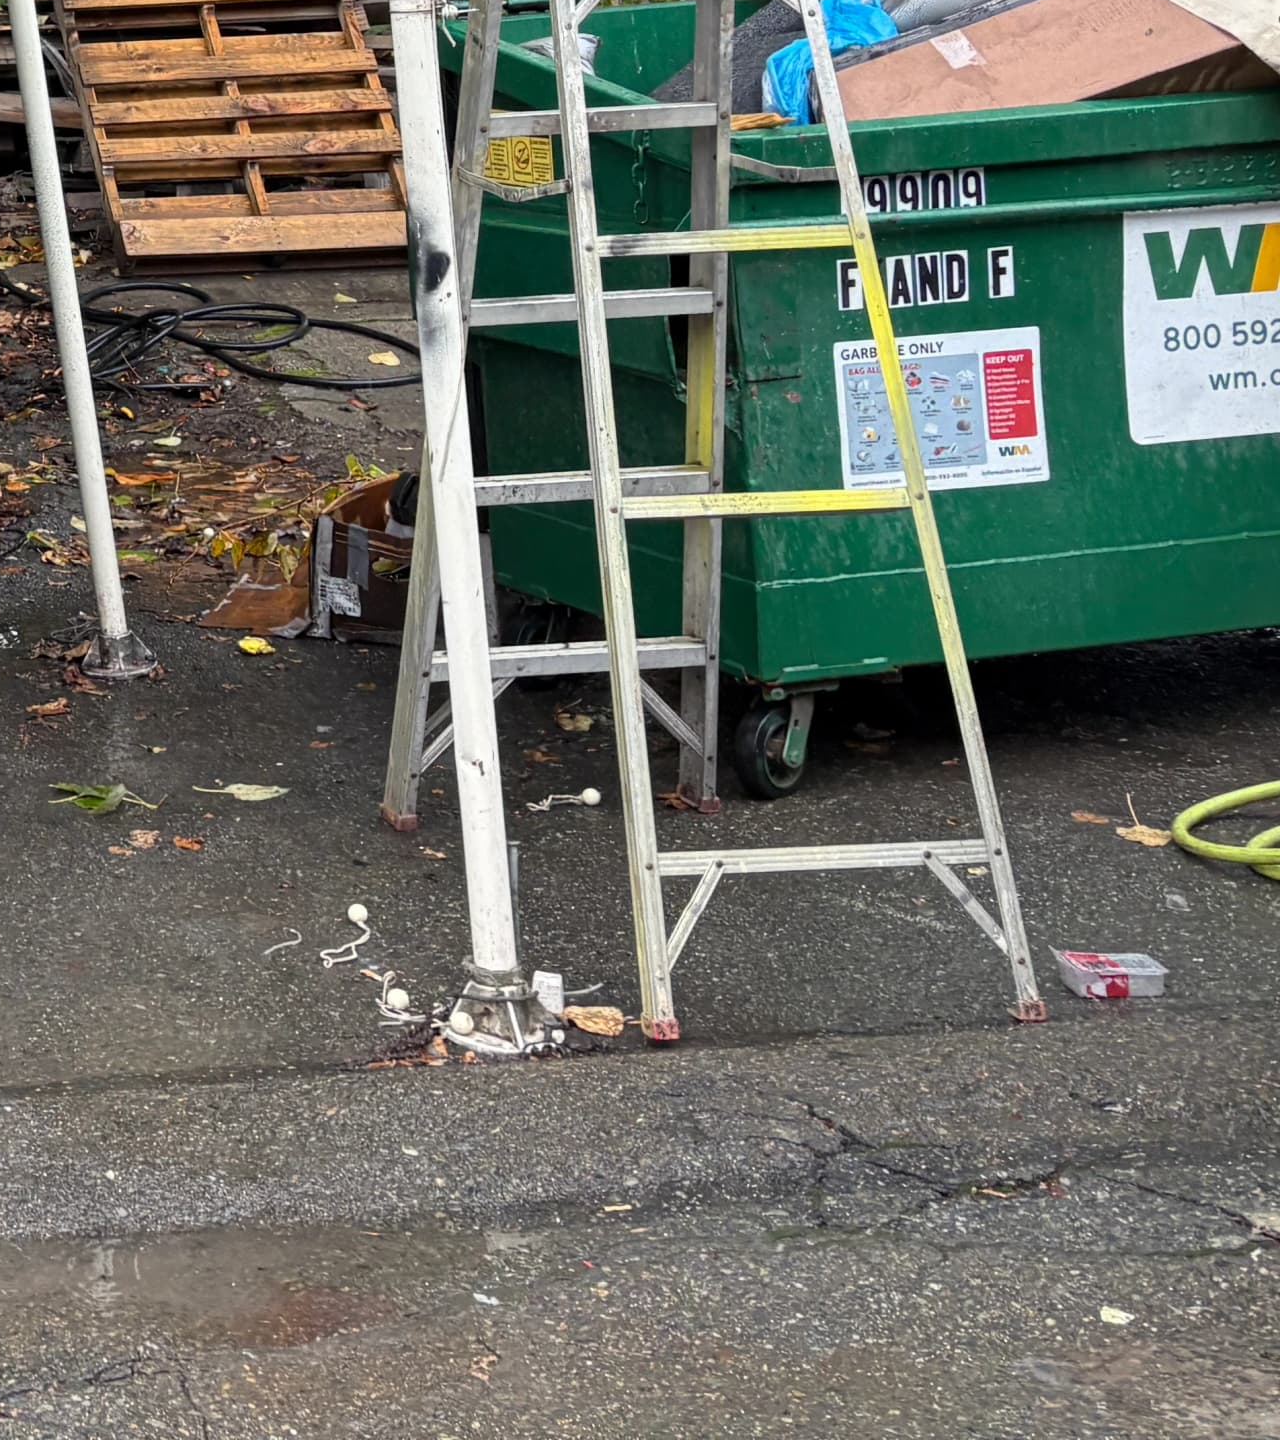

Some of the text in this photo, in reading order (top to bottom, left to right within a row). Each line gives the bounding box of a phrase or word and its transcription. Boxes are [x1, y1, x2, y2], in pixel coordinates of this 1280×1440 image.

[1143, 222, 1280, 301] W
[840, 249, 1009, 308] F AND F
[1163, 323, 1221, 352] 800
[841, 341, 944, 360] GARBE ONLY
[986, 354, 1024, 364] KEEP OUT
[999, 445, 1032, 457] WM
